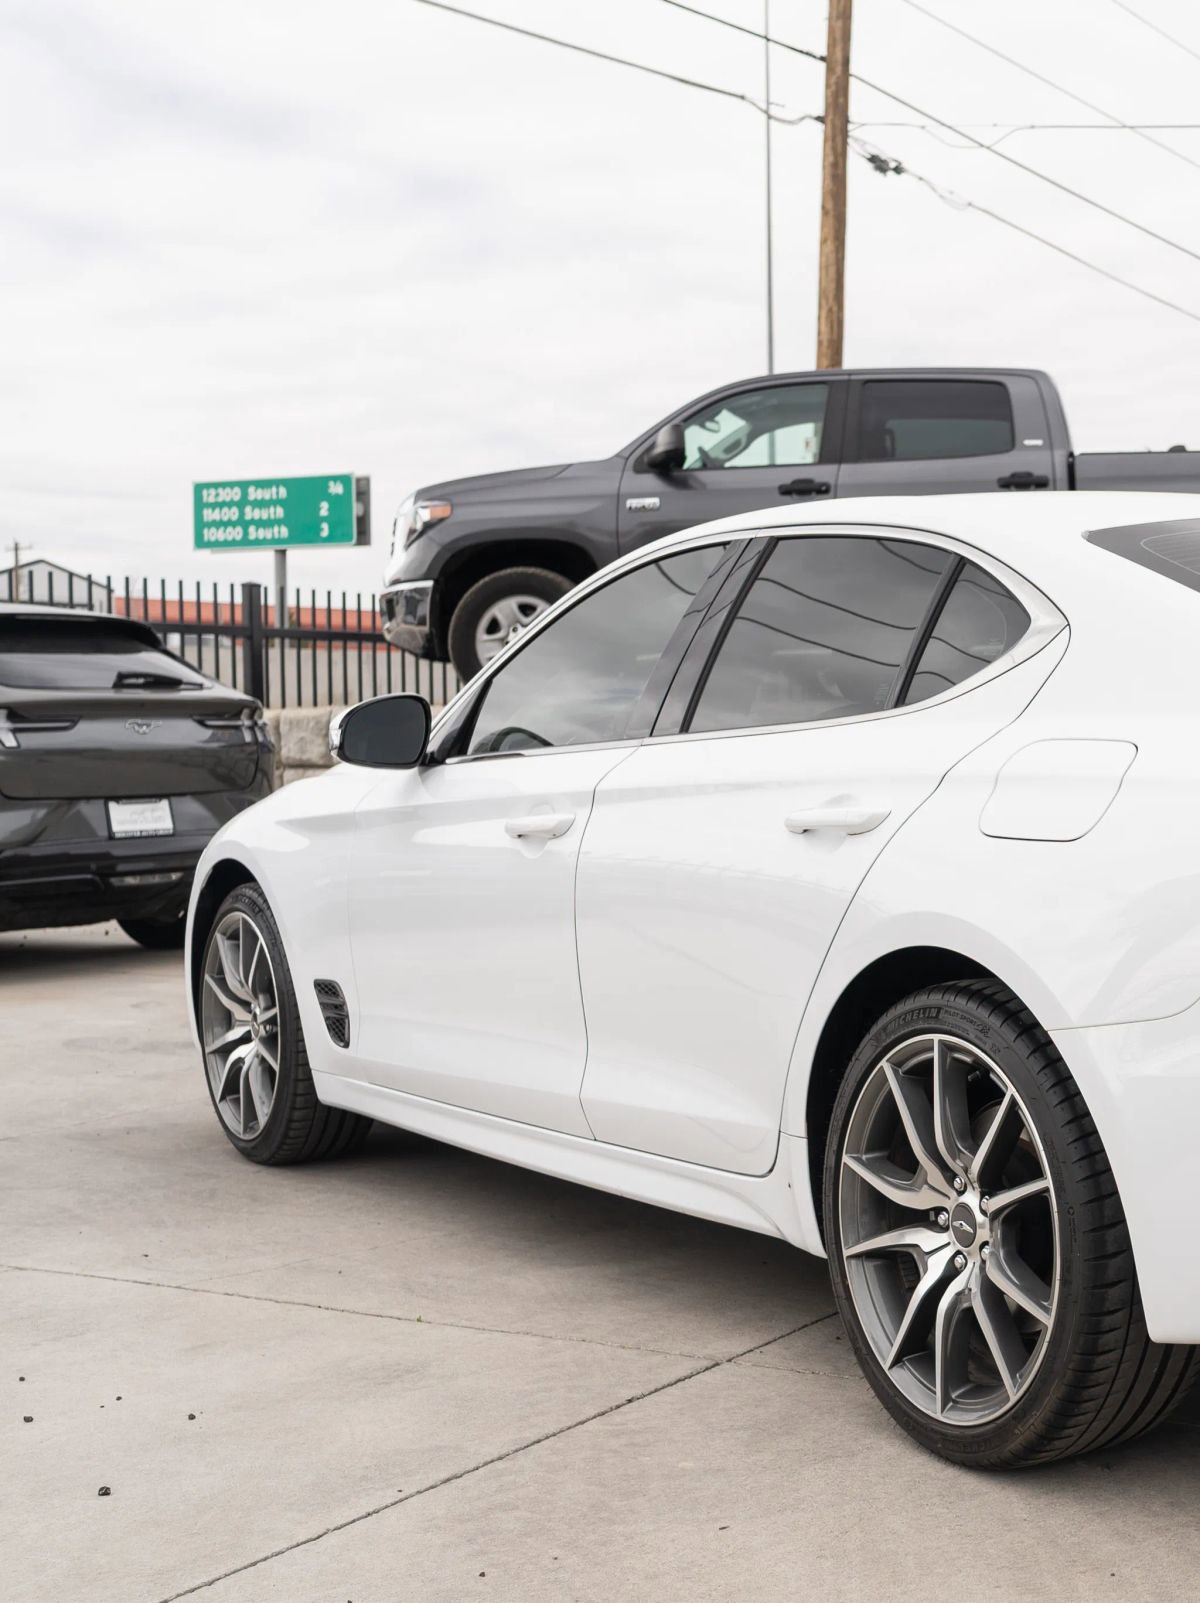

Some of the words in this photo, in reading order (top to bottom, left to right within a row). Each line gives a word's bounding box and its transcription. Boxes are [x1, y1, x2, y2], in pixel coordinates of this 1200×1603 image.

[202, 486, 241, 503] 12300
[247, 484, 287, 500] South
[202, 506, 239, 522] 11400
[244, 504, 285, 520] South
[319, 501, 329, 517] 2
[203, 525, 243, 542] 10600
[248, 524, 289, 540] South
[319, 522, 329, 538] 3
